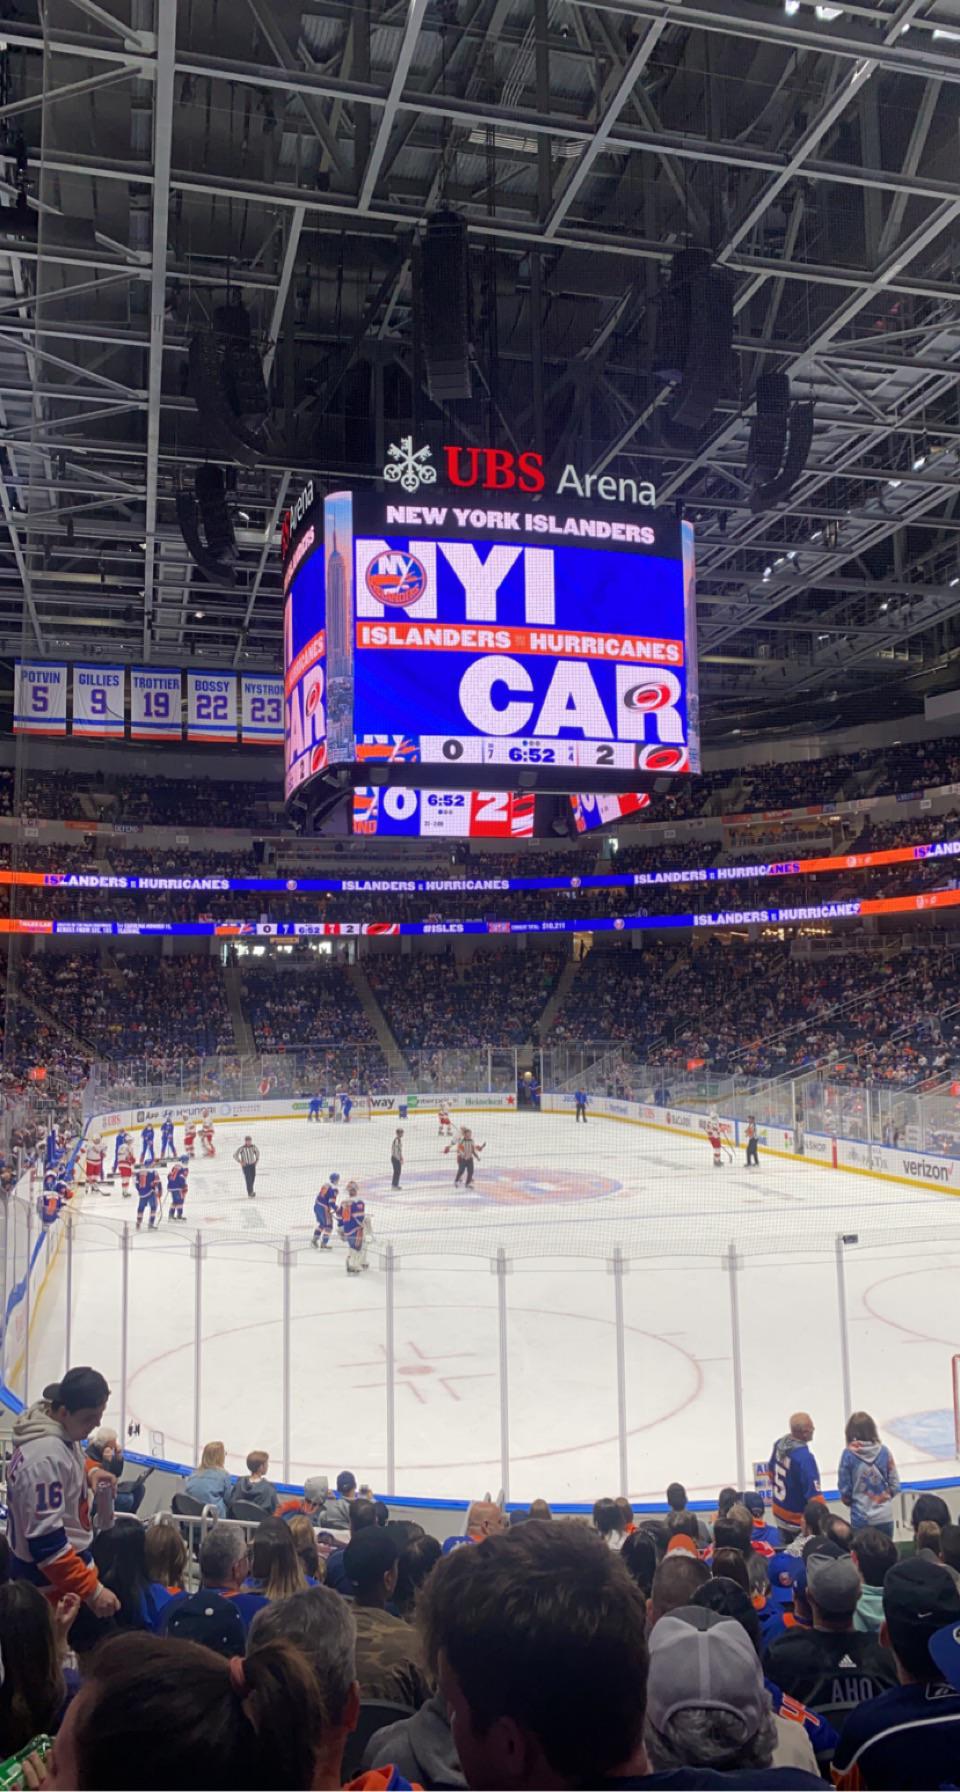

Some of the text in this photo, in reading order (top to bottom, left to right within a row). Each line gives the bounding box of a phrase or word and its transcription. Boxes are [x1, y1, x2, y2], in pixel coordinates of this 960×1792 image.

[443, 446, 656, 506] UBS Arena
[386, 505, 655, 545] NEW YORK ISLANDERS
[356, 539, 556, 625] NYI
[361, 626, 511, 649] ISLANDERS
[530, 633, 680, 662] HURRICANES
[21, 670, 60, 684] POTVIN
[79, 673, 120, 687] GILLIES
[133, 677, 180, 691] TROTTIER
[195, 680, 230, 693] BOSSY
[32, 685, 49, 712] 5
[91, 689, 107, 714] 9
[143, 692, 170, 718] 19
[196, 694, 228, 720] 22
[251, 697, 282, 723] 23
[458, 655, 685, 744] CAR
[285, 664, 327, 771] AR
[442, 739, 464, 760] 0
[509, 747, 556, 763] 6:52
[596, 744, 614, 765] 2
[383, 787, 418, 821] 0
[427, 794, 465, 807] 6:52
[475, 791, 510, 822] 2
[44, 874, 128, 888] ISLANDERS
[138, 874, 230, 890] HURRICANES
[342, 880, 416, 891] ISLANDERS
[425, 880, 510, 890] HURRICANES
[634, 863, 800, 885] ISLANDERS HURRICANES
[693, 903, 861, 926] ISLANDERS HURRICANES
[263, 925, 272, 934] 0
[346, 925, 354, 933] 2
[423, 924, 464, 934] #ISLES
[903, 1159, 949, 1182] verizon
[35, 1481, 63, 1512] 16
[832, 1677, 874, 1704] AHO
